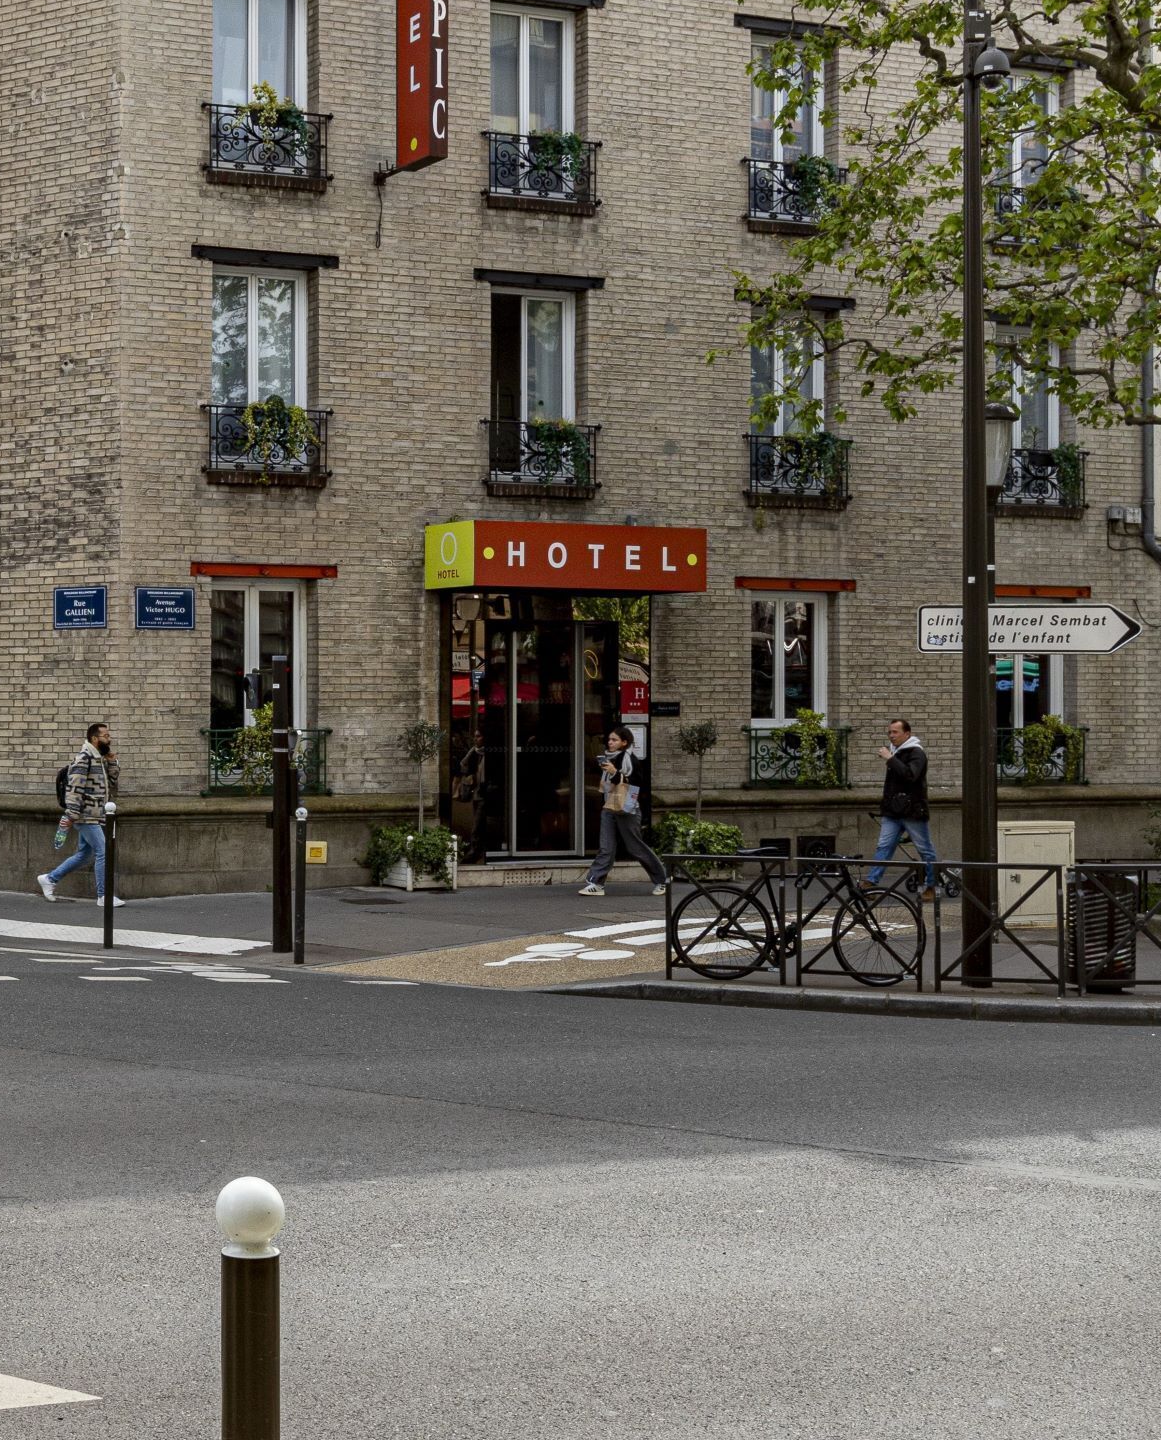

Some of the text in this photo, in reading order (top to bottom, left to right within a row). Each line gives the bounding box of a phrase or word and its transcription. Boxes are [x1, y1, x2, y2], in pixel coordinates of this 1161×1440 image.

[507, 541, 677, 572] HOTEL
[437, 569, 460, 580] HOTEL
[73, 599, 86, 607] Rue
[65, 608, 95, 616] GALLIENI
[927, 614, 1107, 626] clini Marcel Sembat
[989, 632, 1005, 644] de
[1012, 632, 1071, 644] l'enfant
[635, 687, 645, 699] H
